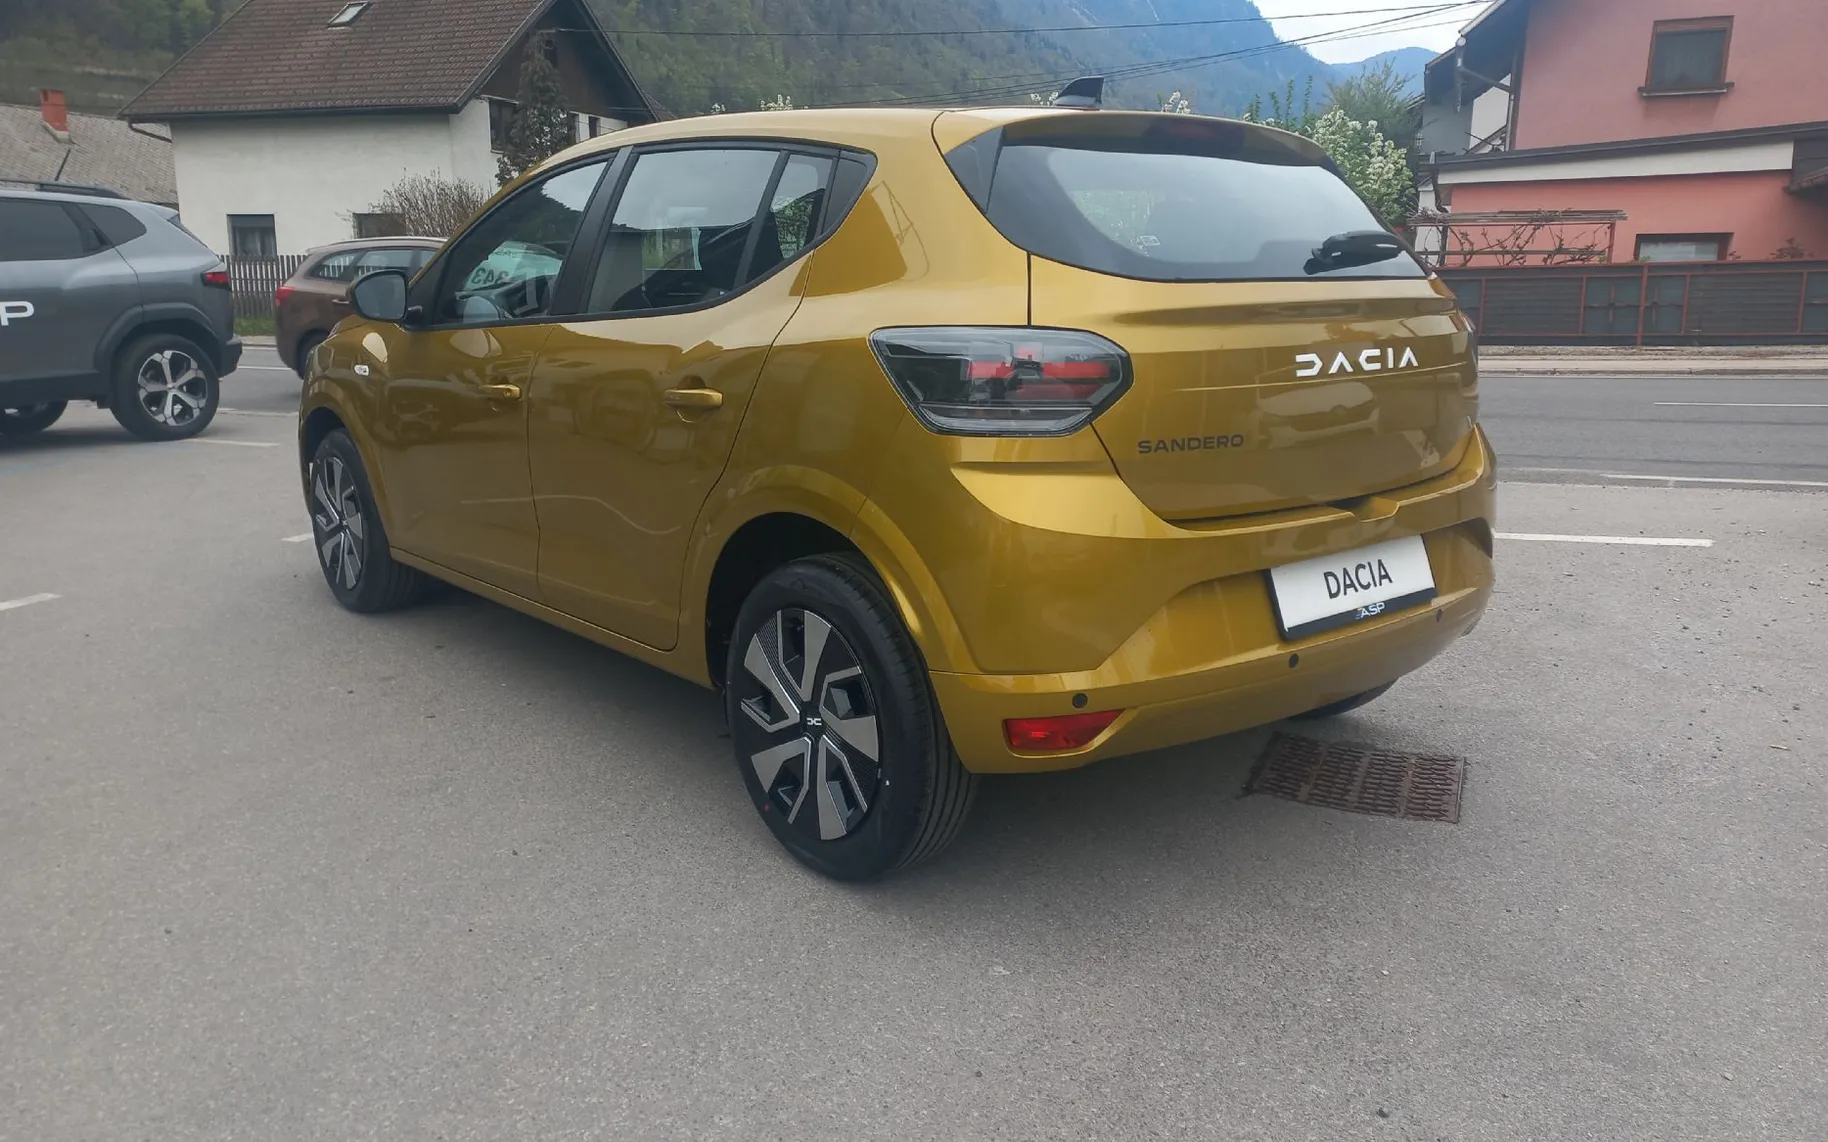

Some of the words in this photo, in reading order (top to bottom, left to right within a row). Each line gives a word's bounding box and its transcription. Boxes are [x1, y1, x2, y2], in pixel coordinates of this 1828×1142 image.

[1296, 347, 1419, 377] DACIA
[1138, 434, 1244, 454] SANDERO
[1323, 559, 1393, 600] DACIA
[1360, 602, 1386, 619] ASP
